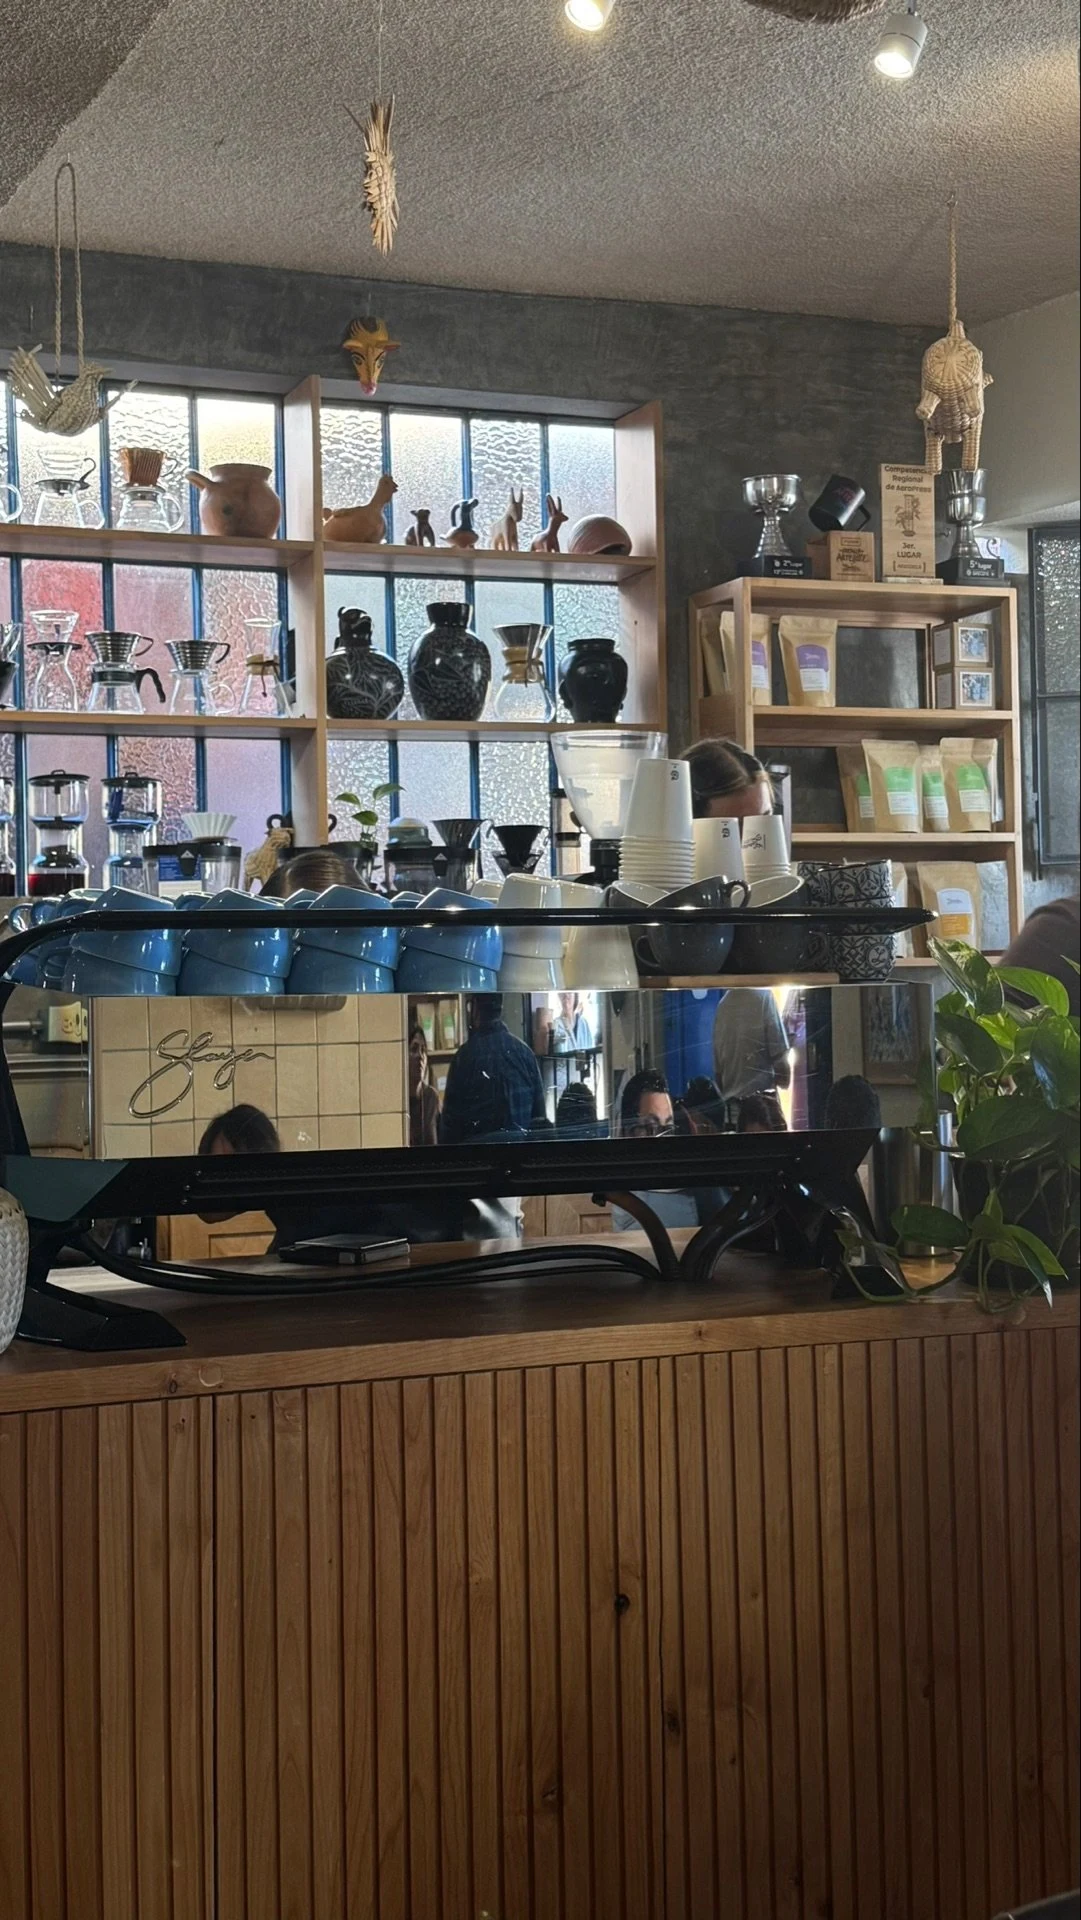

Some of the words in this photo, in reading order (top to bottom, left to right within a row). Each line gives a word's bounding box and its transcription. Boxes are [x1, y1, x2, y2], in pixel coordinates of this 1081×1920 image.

[892, 475, 924, 483] Regional
[897, 551, 922, 559] LUGAR
[128, 1029, 276, 1119] Slayer
